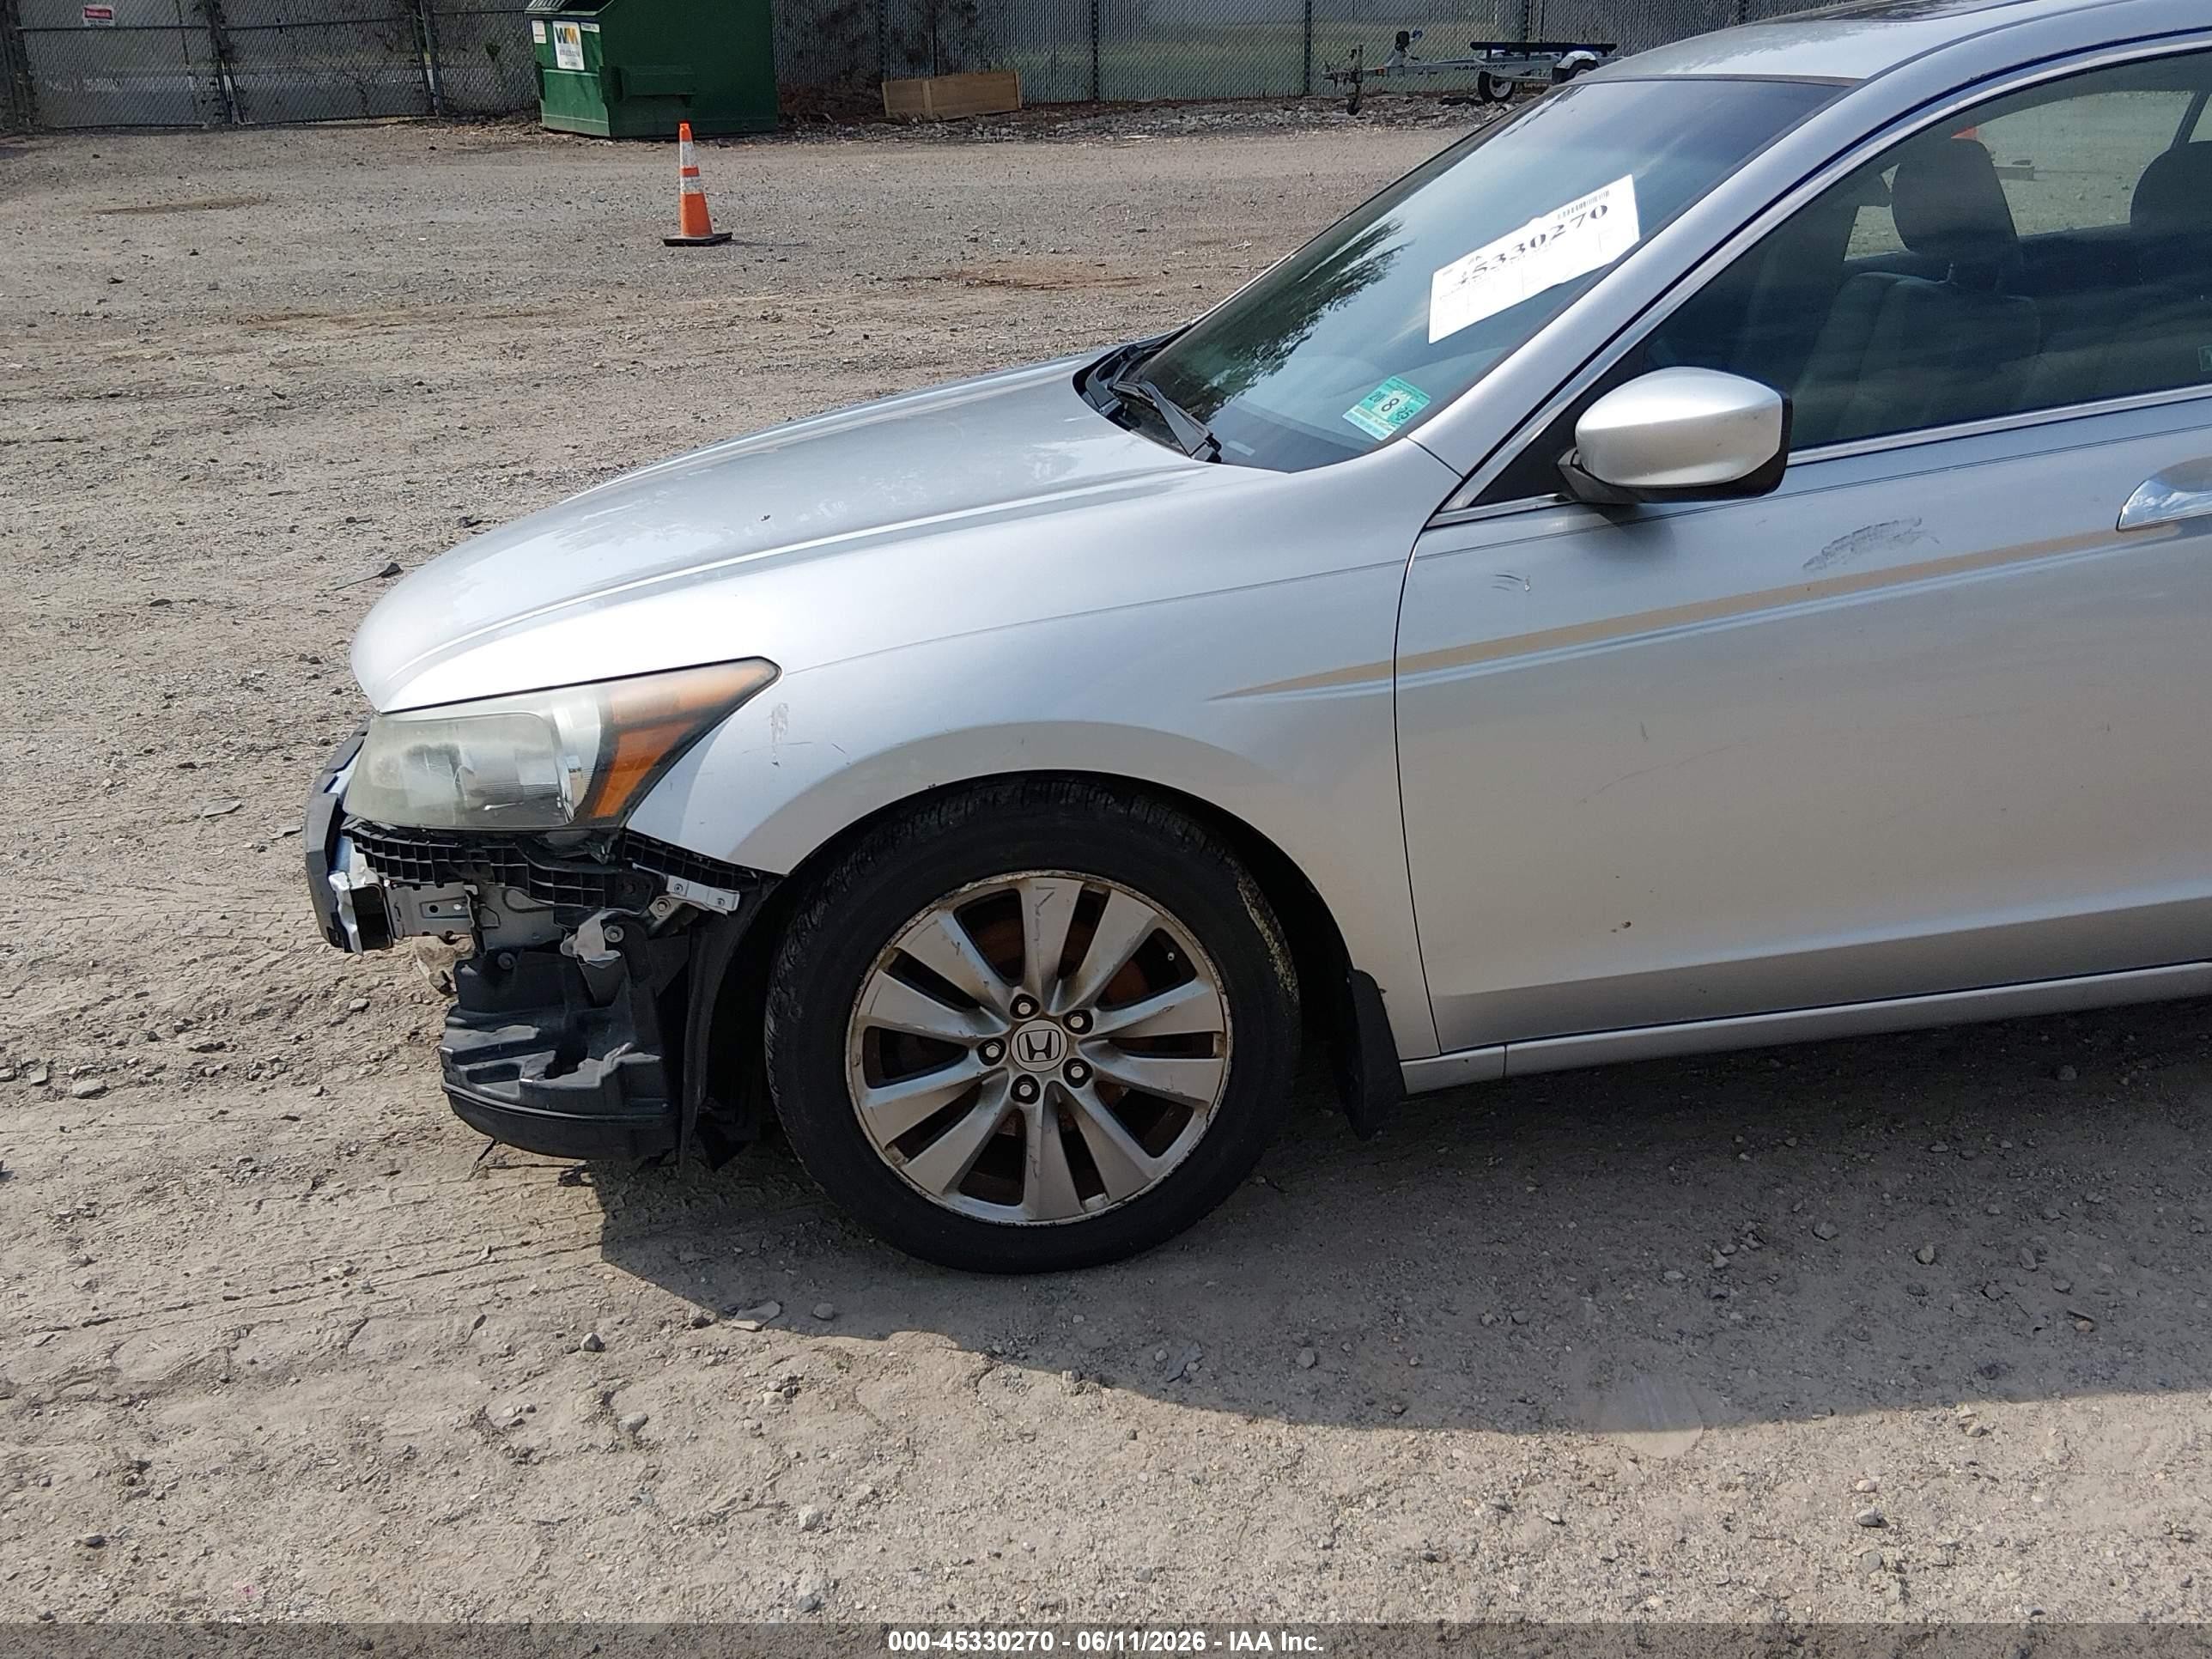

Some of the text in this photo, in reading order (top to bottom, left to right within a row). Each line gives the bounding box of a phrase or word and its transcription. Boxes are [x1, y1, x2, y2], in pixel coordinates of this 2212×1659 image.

[555, 27, 579, 45] WM
[1381, 398, 1400, 412] 8
[1395, 406, 1414, 421] 25
